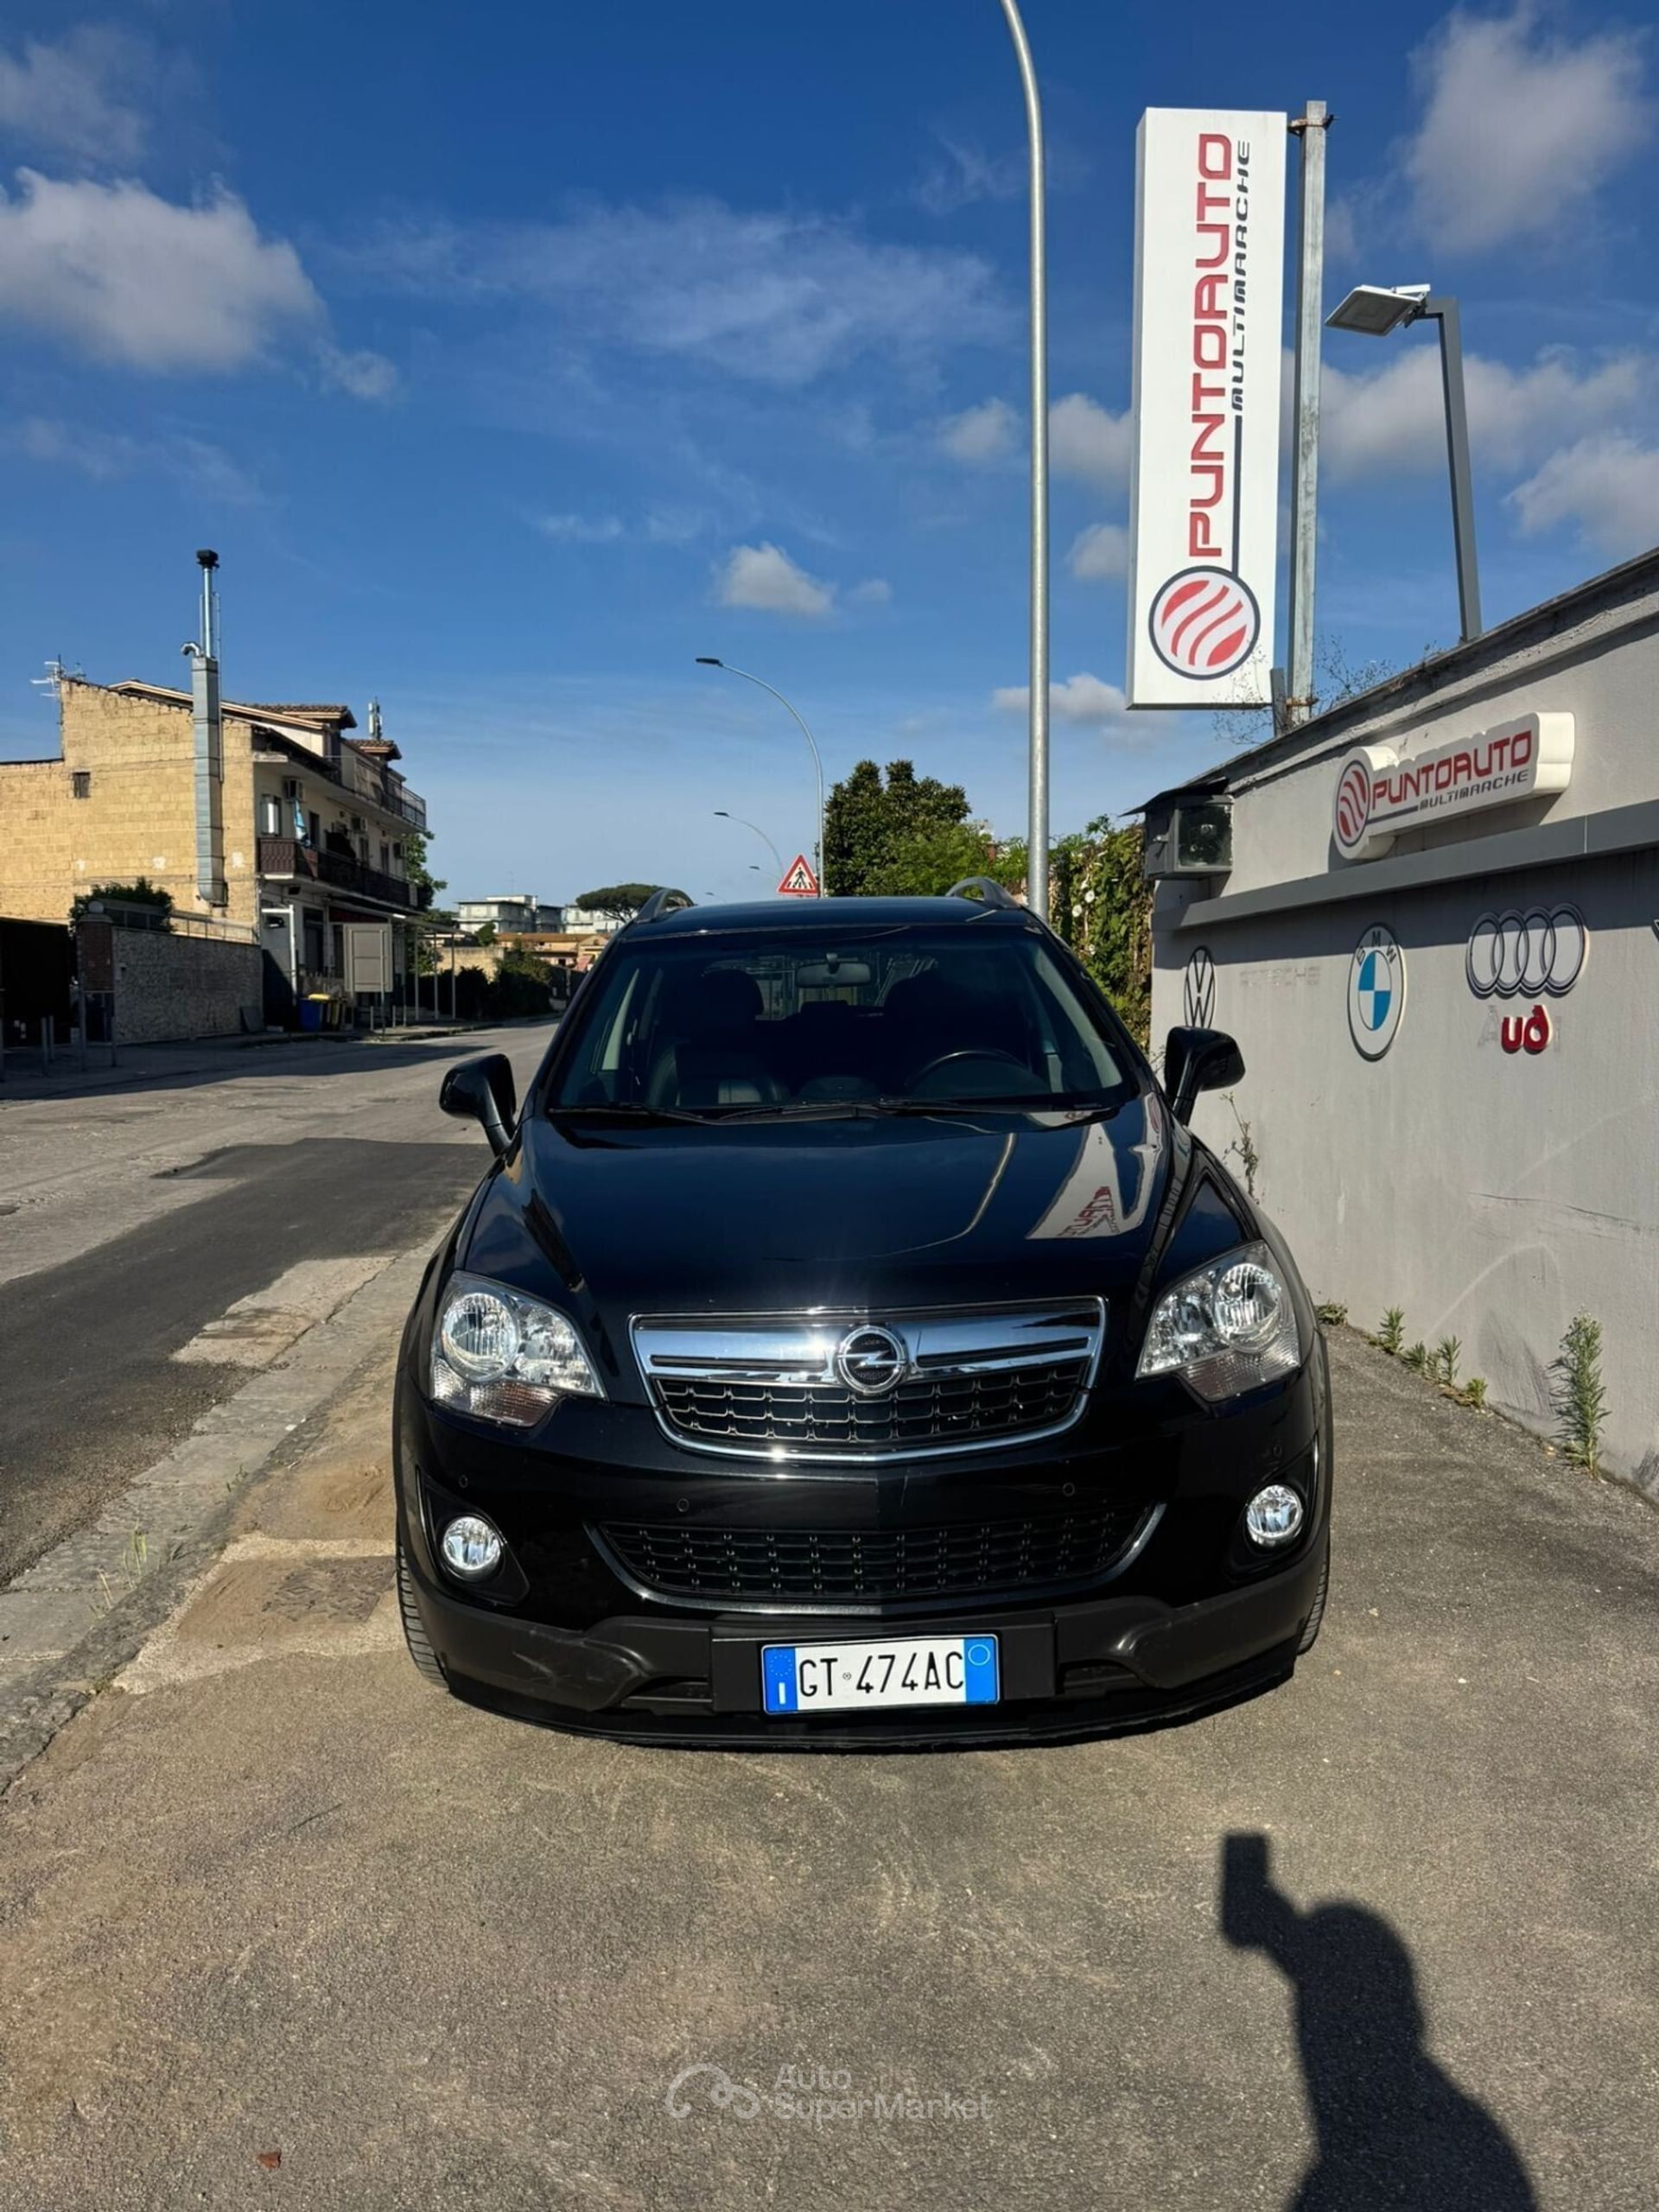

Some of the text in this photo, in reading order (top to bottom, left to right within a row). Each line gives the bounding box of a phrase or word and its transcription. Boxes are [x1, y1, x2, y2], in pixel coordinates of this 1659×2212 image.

[1231, 139, 1251, 412] MULTIMARCHE
[1189, 133, 1231, 557] PUNTOAUTO
[1372, 731, 1532, 810] PUNTOAUTO
[1419, 769, 1529, 811] MULTIMARCHE
[1355, 931, 1396, 966] BMW
